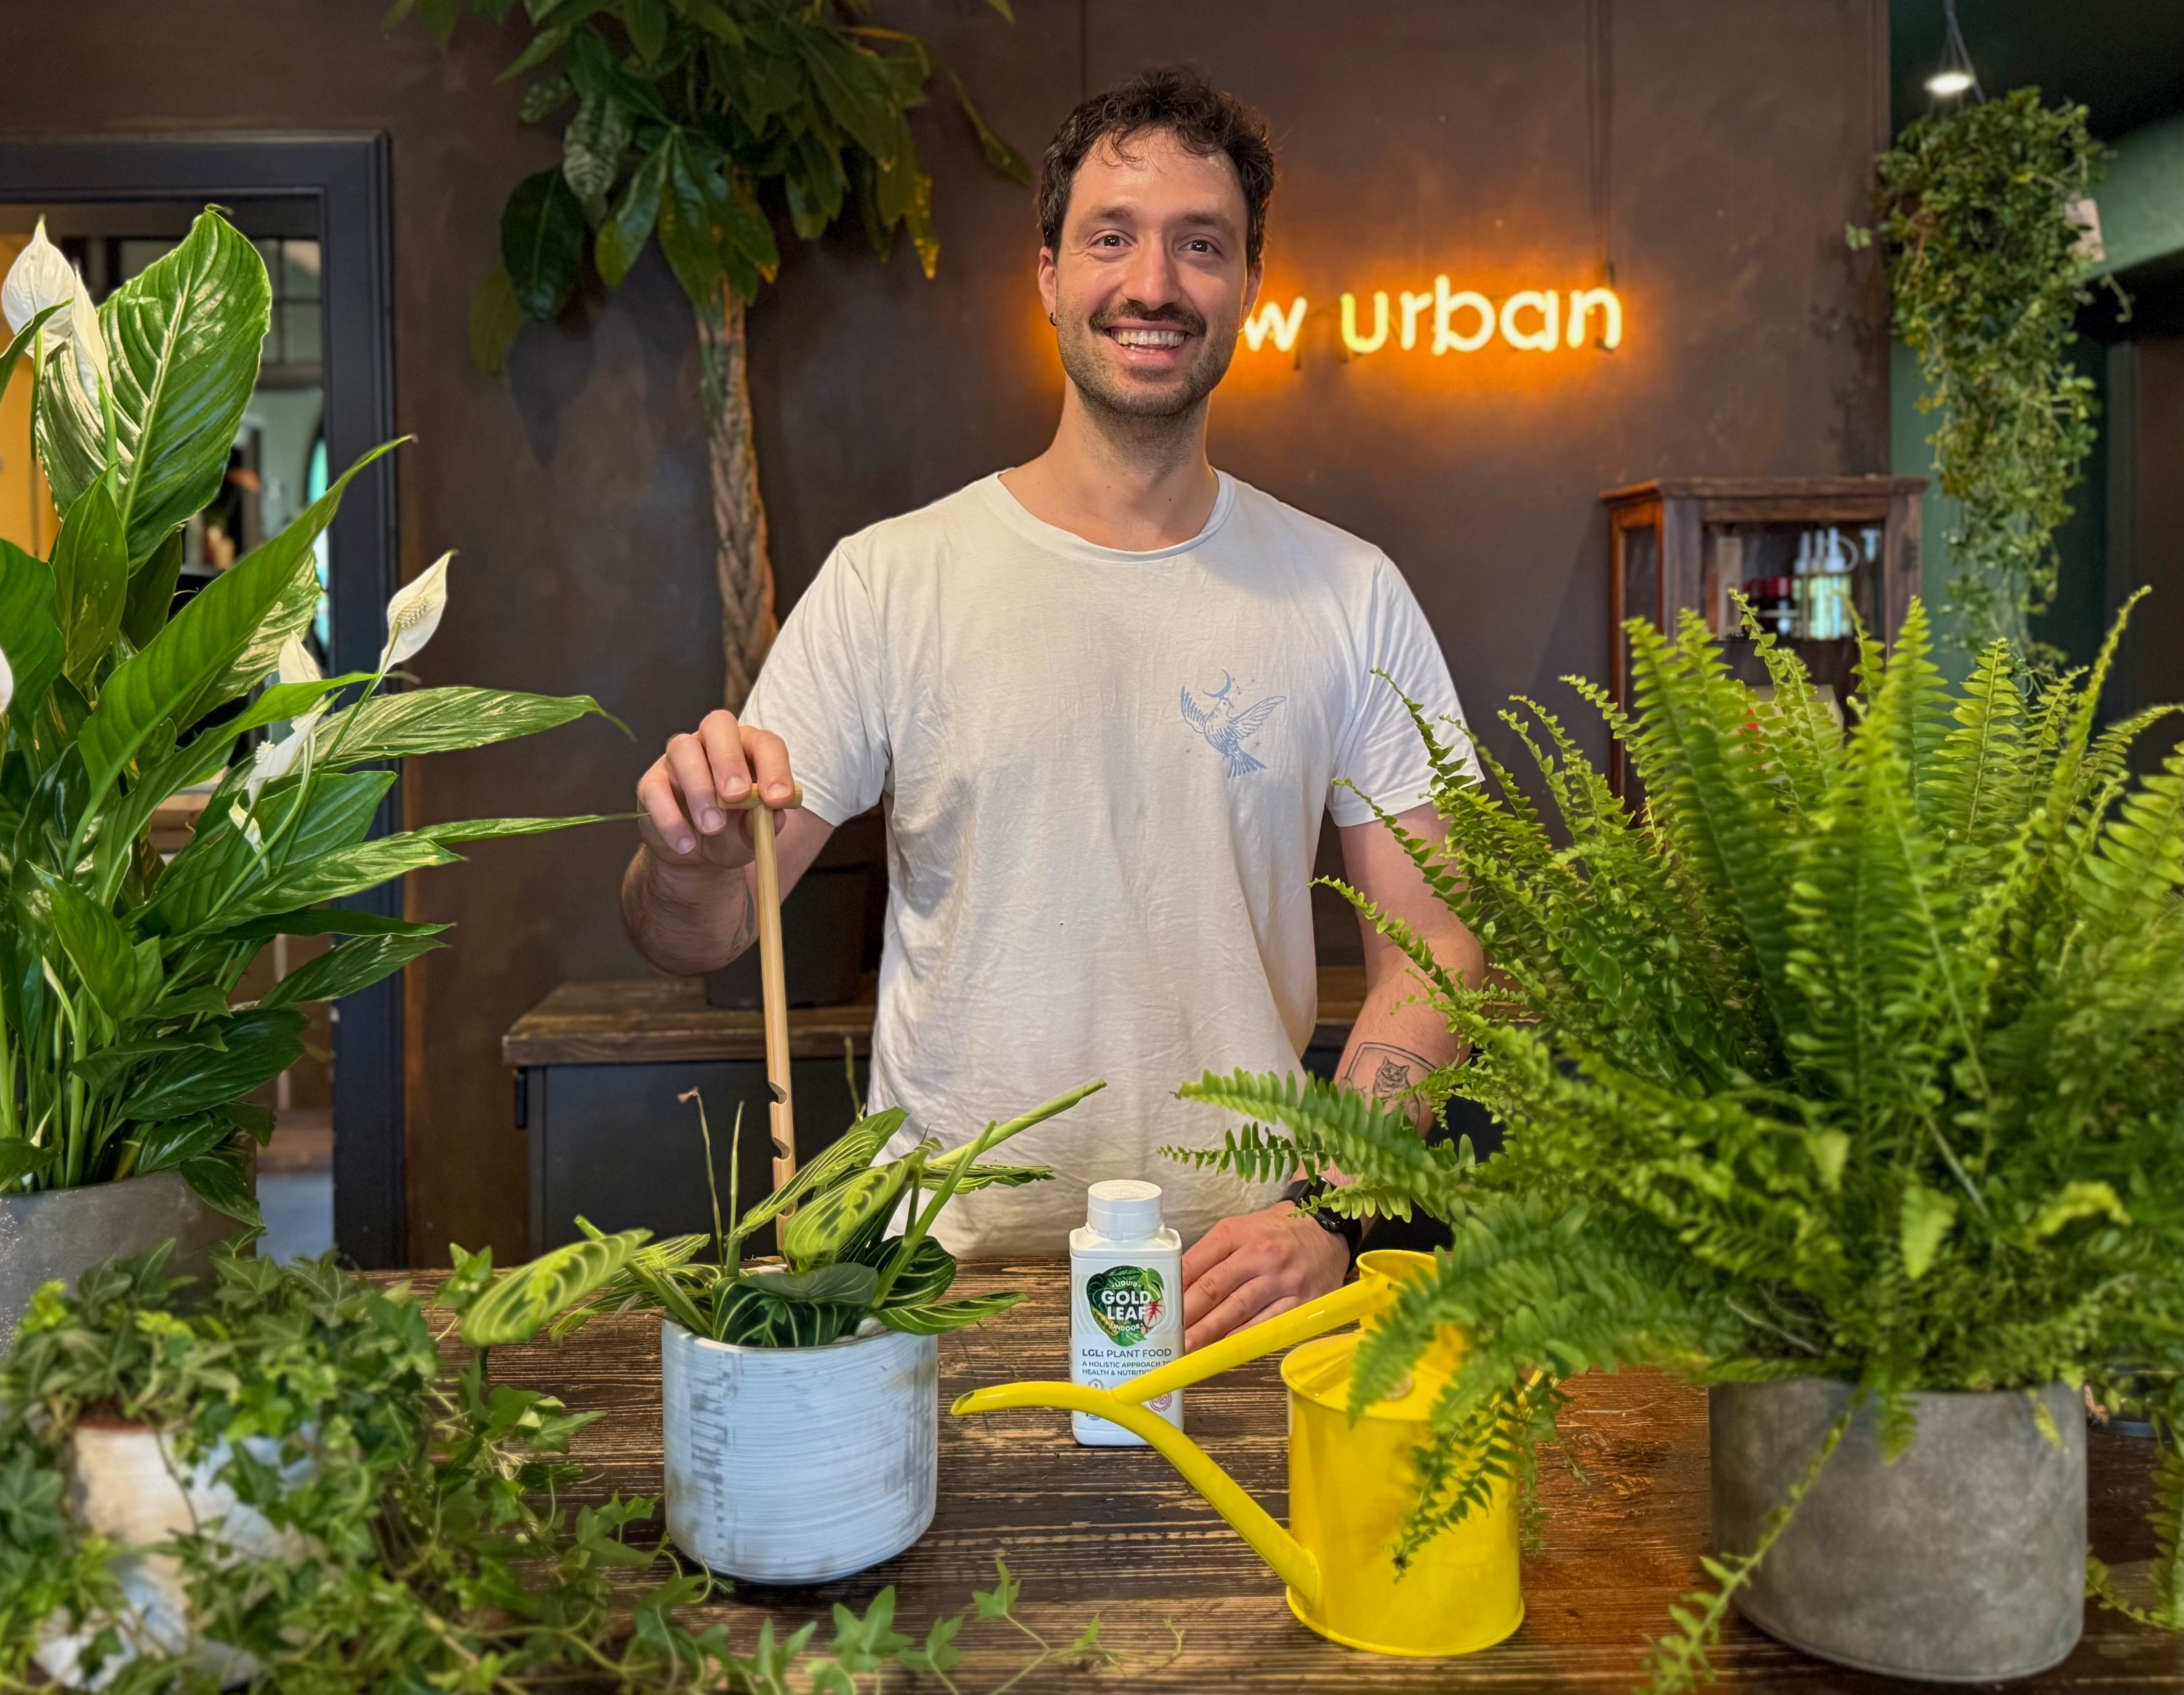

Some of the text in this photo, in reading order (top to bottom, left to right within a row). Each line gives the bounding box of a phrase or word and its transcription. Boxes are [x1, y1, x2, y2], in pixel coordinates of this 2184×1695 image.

[1341, 274, 1623, 356] urban
[1101, 1290, 1151, 1305] GOLD
[1107, 1306, 1146, 1321] LEAF
[1082, 1348, 1171, 1358] LGL: PLANT FOOD
